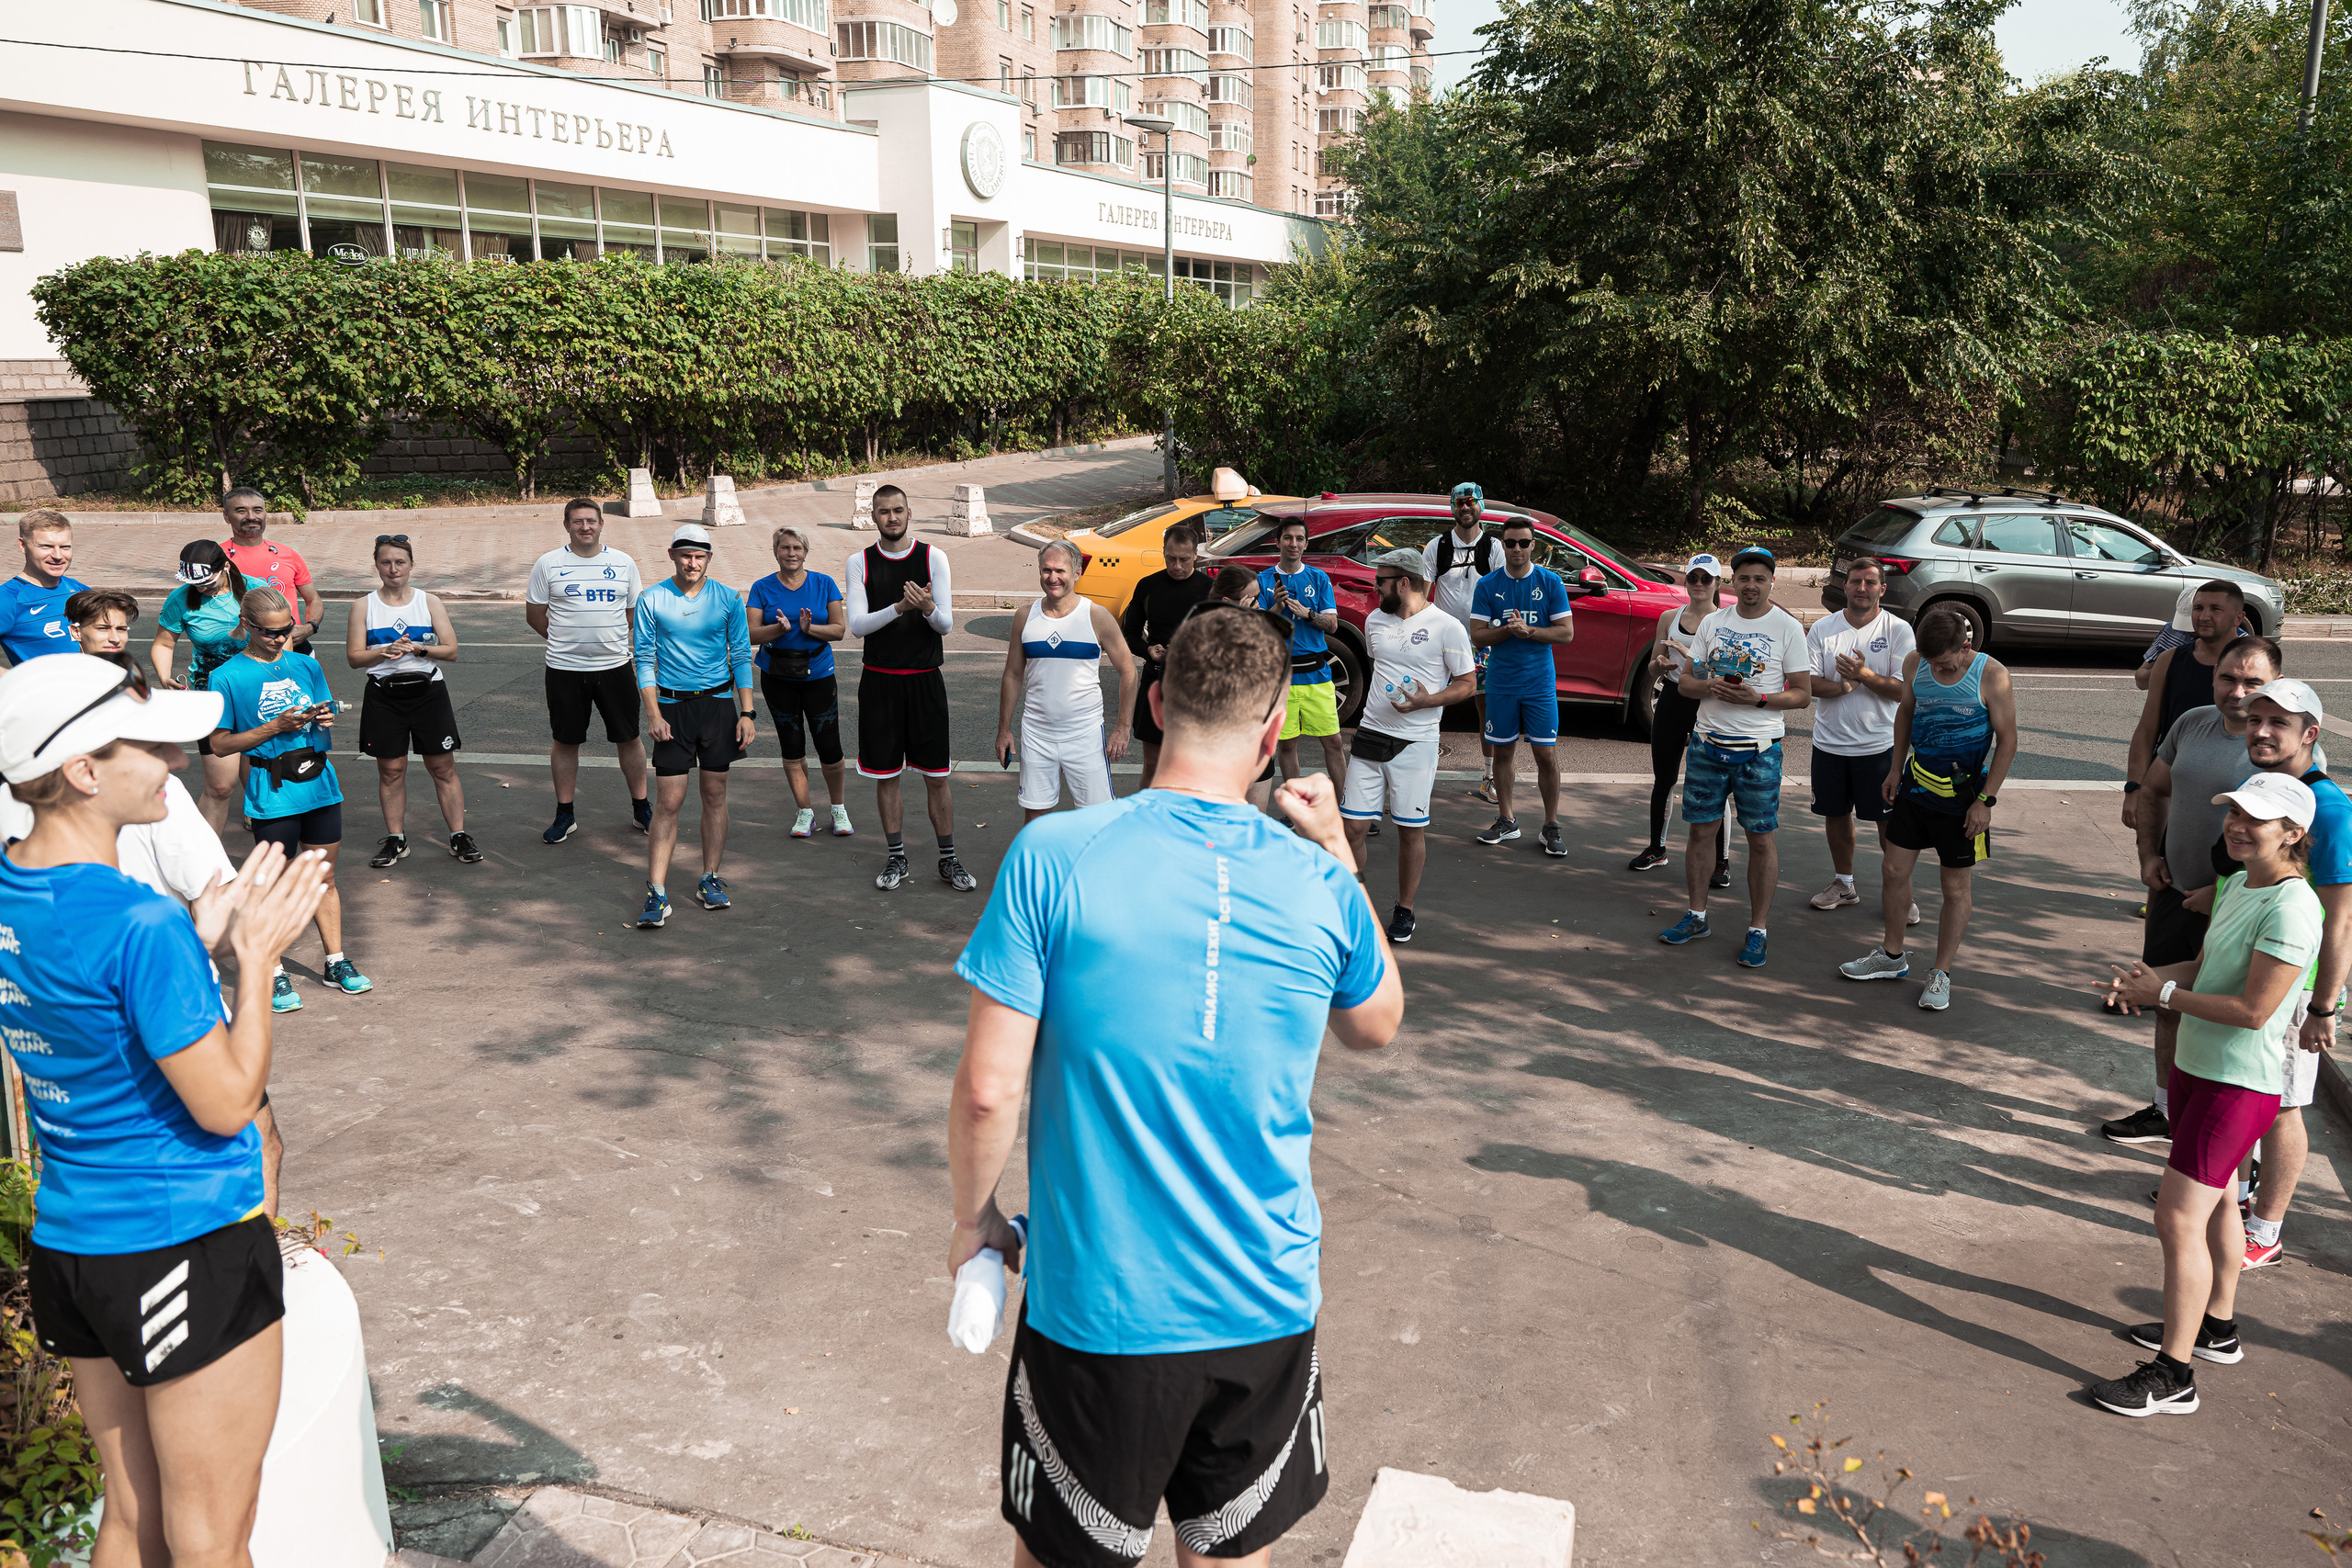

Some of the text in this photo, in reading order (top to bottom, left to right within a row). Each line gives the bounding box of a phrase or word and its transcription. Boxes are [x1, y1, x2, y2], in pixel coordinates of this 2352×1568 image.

[240, 58, 675, 158] ГАЛЕРЕЯ ИНТЕРЬЕРА
[1098, 202, 1232, 241] ГАЛЕРЕЯ НТЕРЬЕРА
[586, 589, 616, 602] ВТБ
[1514, 610, 1538, 625] ТБ
[1218, 896, 1231, 924] ВСЕ
[1202, 918, 1220, 1042] ДИНАМО БЕЖИТ
